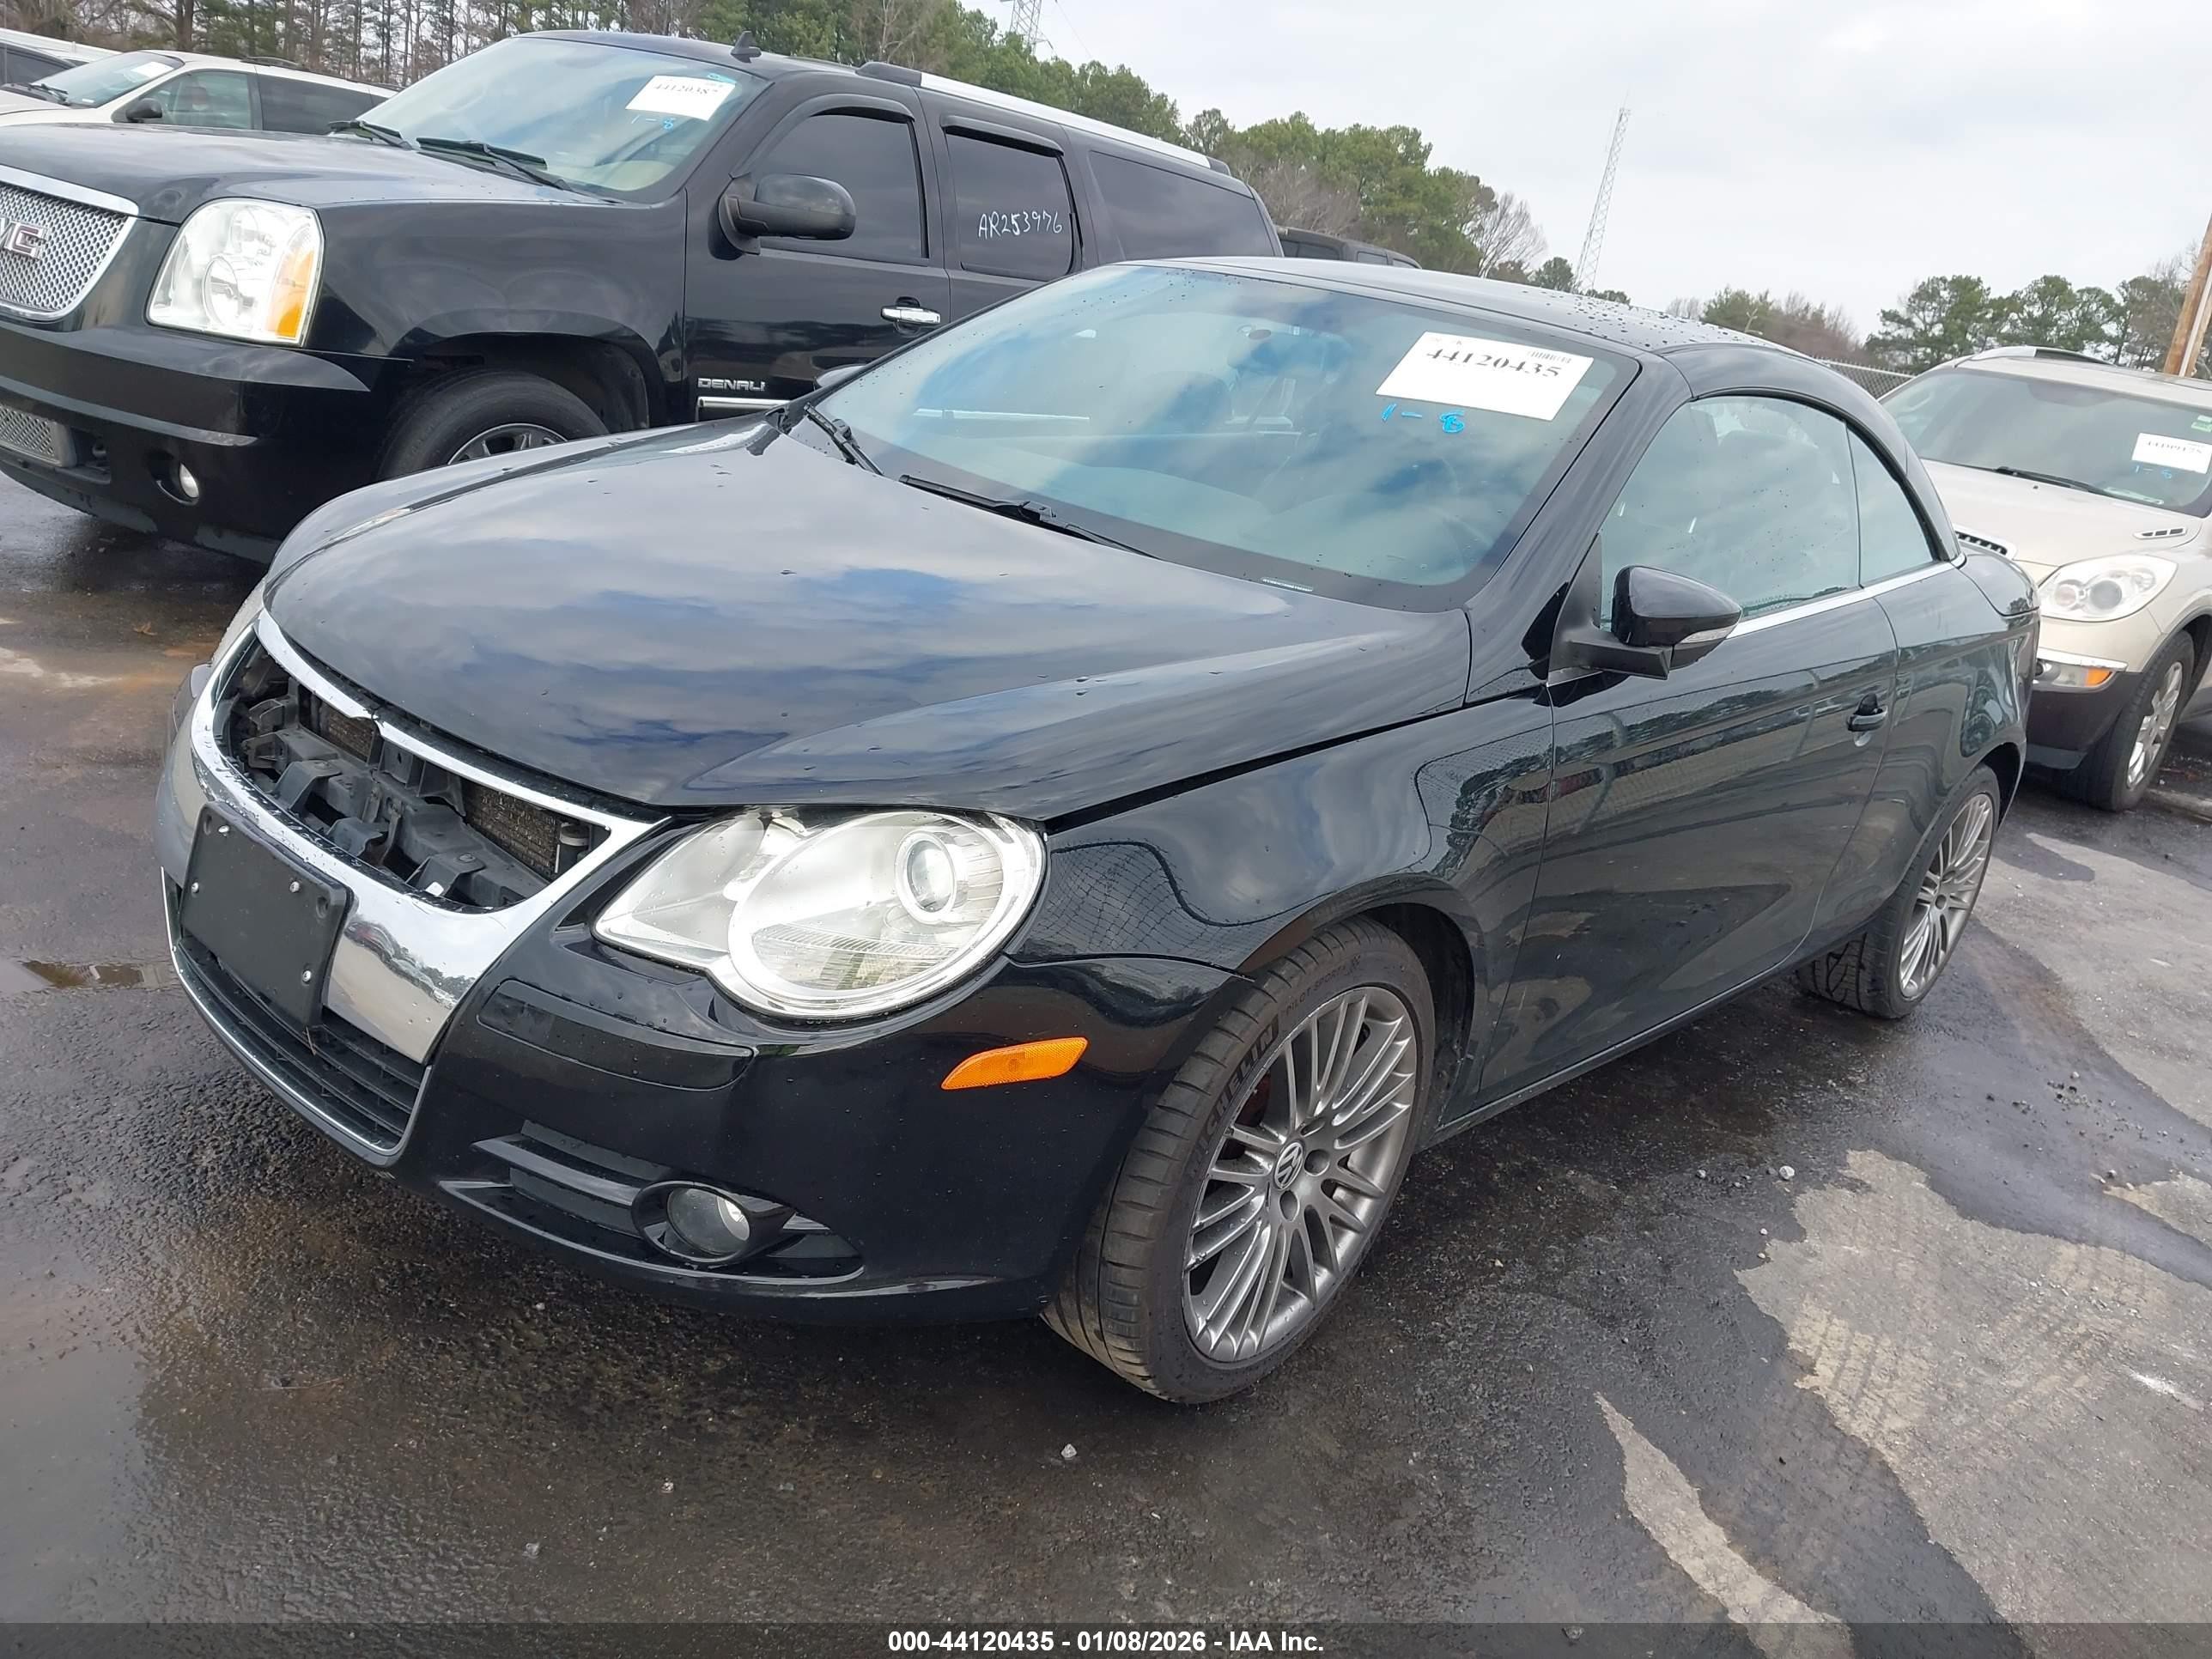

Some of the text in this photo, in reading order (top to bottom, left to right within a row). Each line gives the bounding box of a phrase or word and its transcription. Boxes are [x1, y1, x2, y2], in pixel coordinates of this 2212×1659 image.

[978, 210, 1062, 239] AR253976
[1426, 349, 1562, 378] 44120435
[697, 377, 766, 391] DENALI
